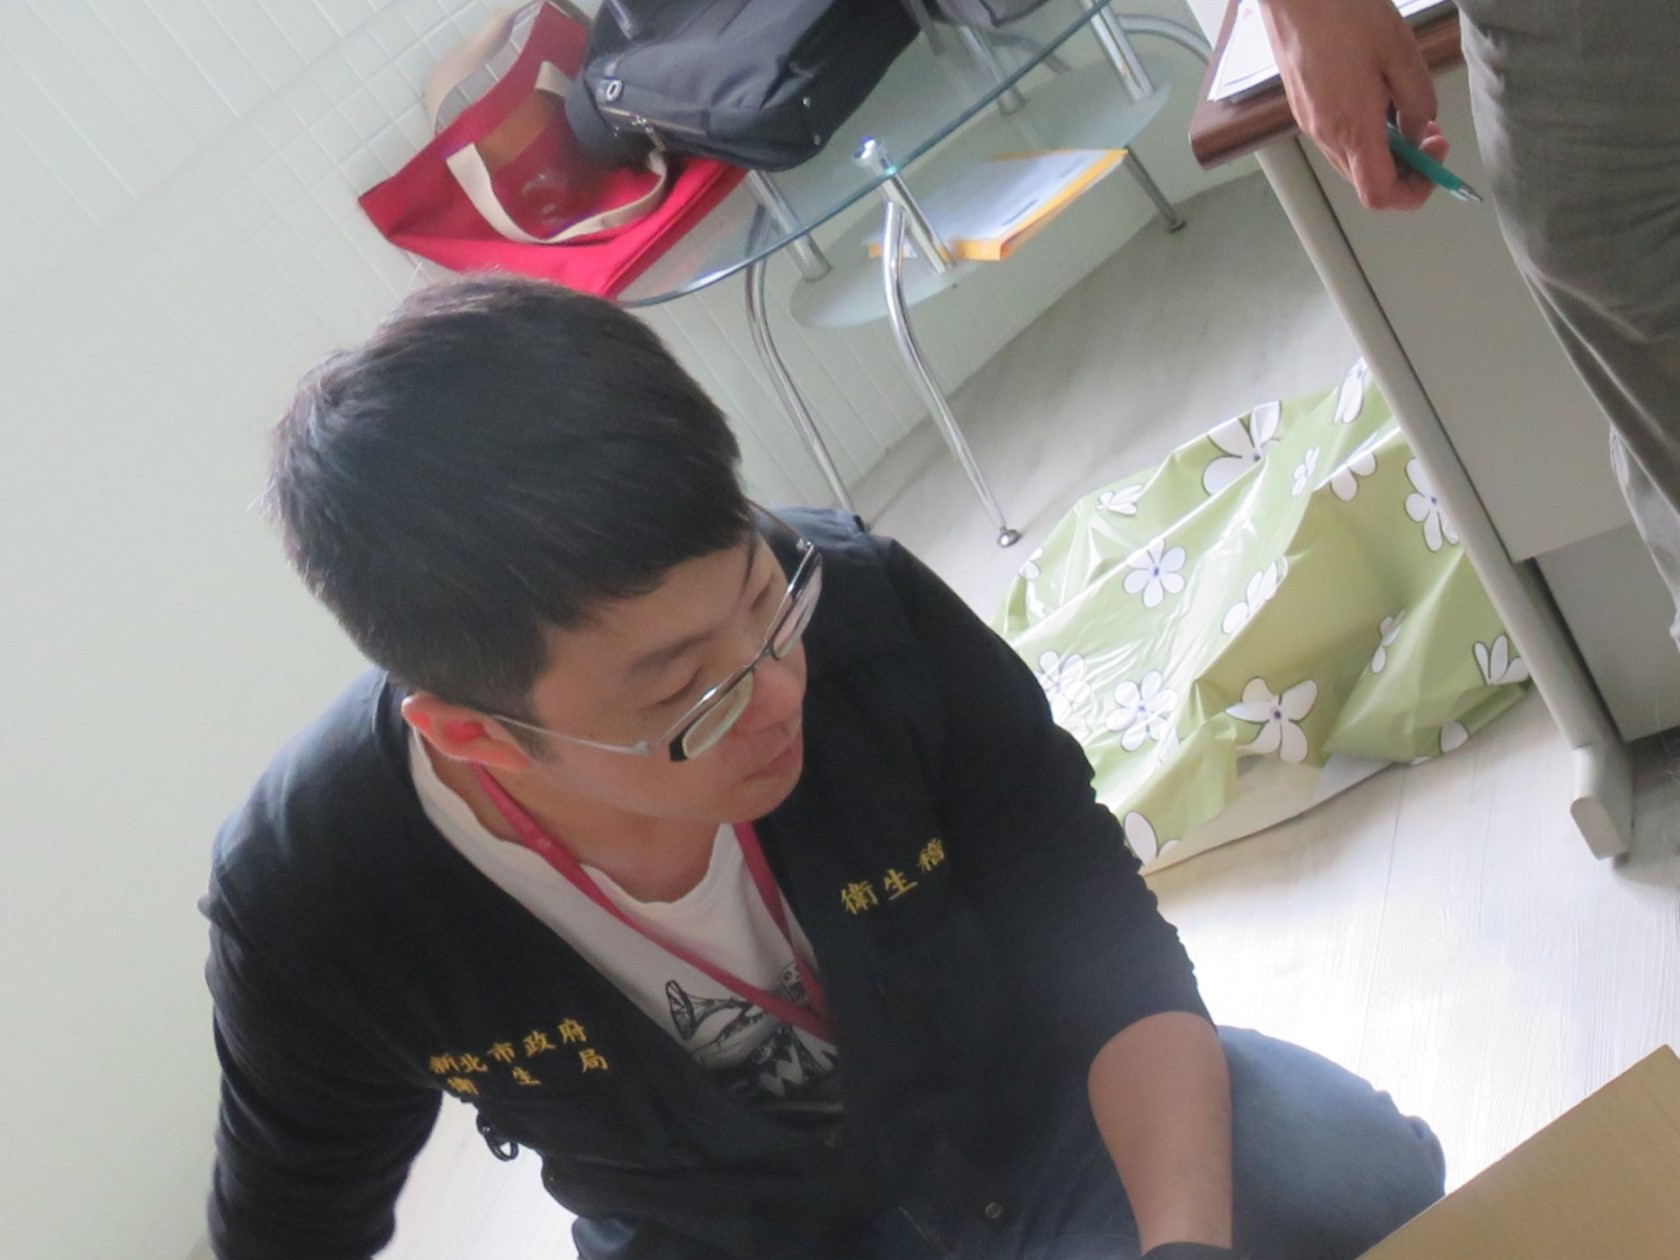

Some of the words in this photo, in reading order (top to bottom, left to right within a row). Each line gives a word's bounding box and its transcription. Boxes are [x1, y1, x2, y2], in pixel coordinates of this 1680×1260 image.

[428, 1017, 588, 1075] 新北市政府
